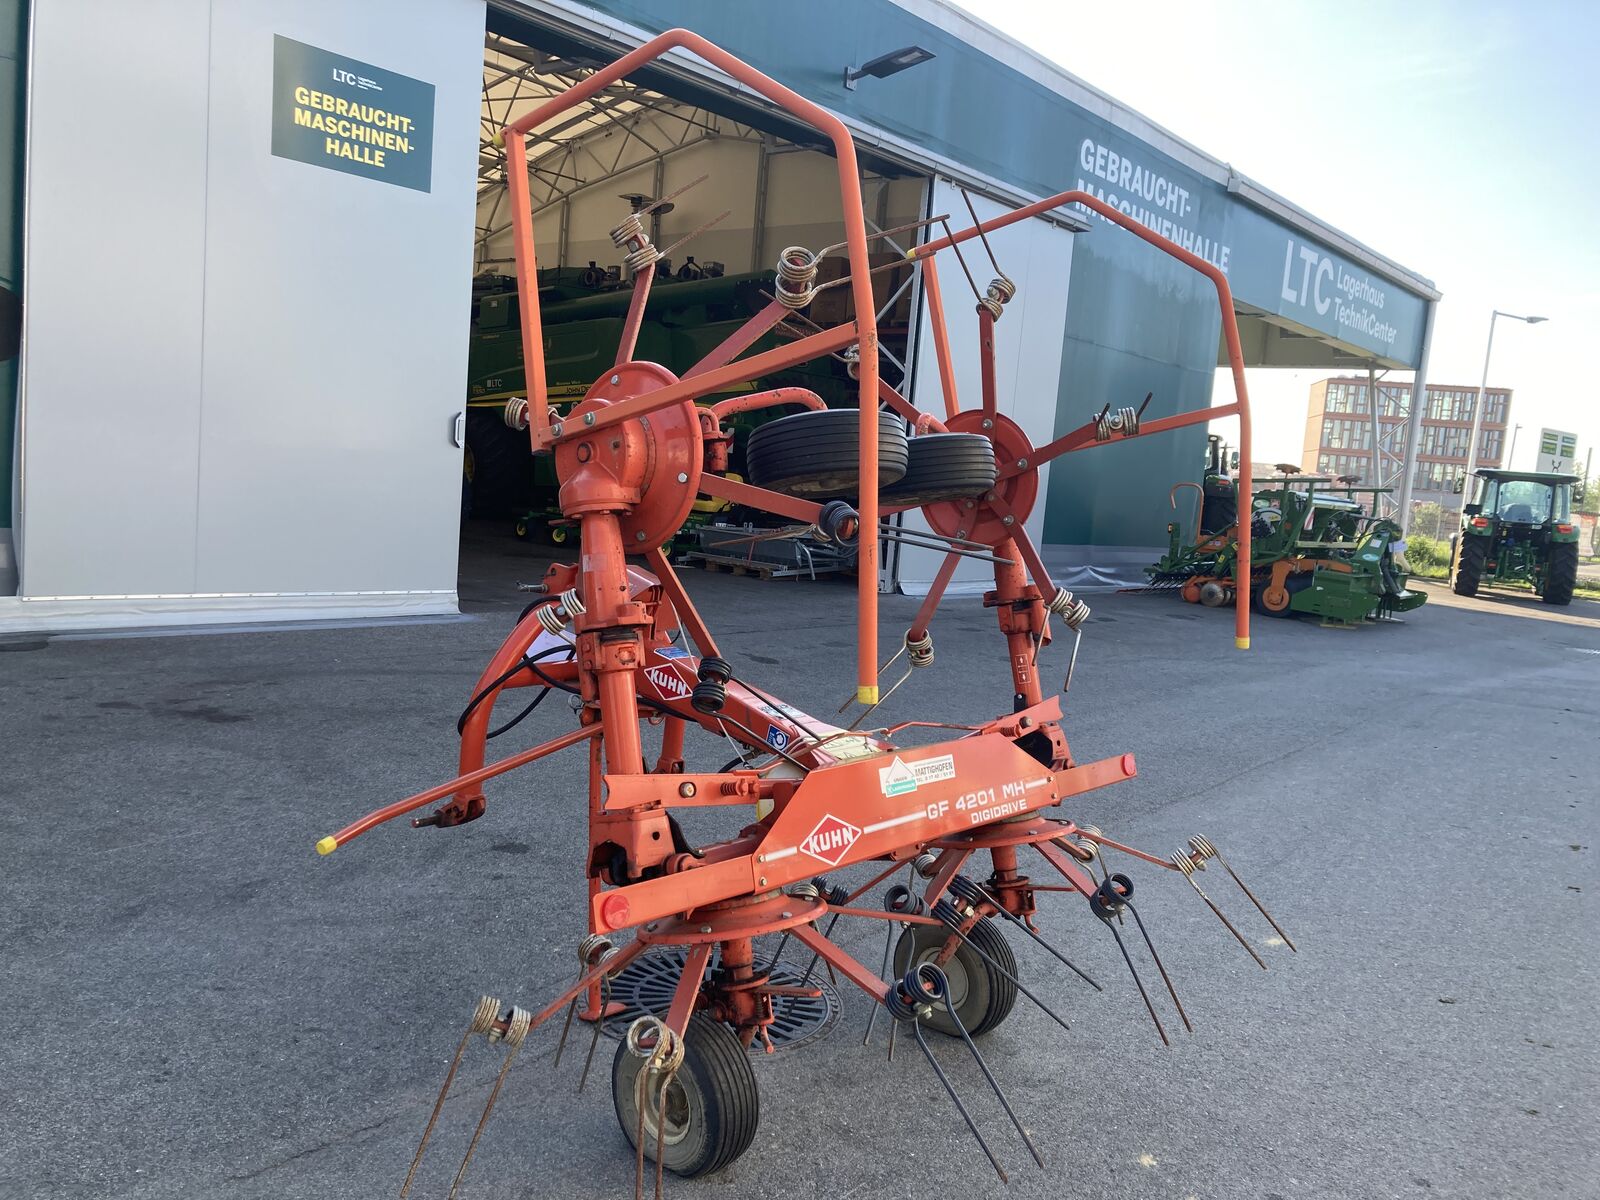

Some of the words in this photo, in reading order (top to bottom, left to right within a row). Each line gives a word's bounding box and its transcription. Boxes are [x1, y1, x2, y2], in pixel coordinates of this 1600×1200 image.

[333, 68, 356, 86] LTC
[294, 86, 415, 133] GEBRAUCHT-
[294, 107, 415, 153] MASCHINEN-
[325, 137, 385, 168] HALLE
[1080, 138, 1191, 218] GEBRAUCHT-
[1281, 239, 1334, 316] LTC
[1336, 264, 1385, 309] Lagerhaus
[1334, 296, 1397, 344] TechnikCenter
[650, 668, 687, 697] KUHN
[927, 800, 949, 819] GF
[955, 788, 995, 811] 4201
[1002, 781, 1025, 799] MH
[970, 799, 1028, 824] DIGIDRIVE
[808, 825, 854, 854] KUHN
